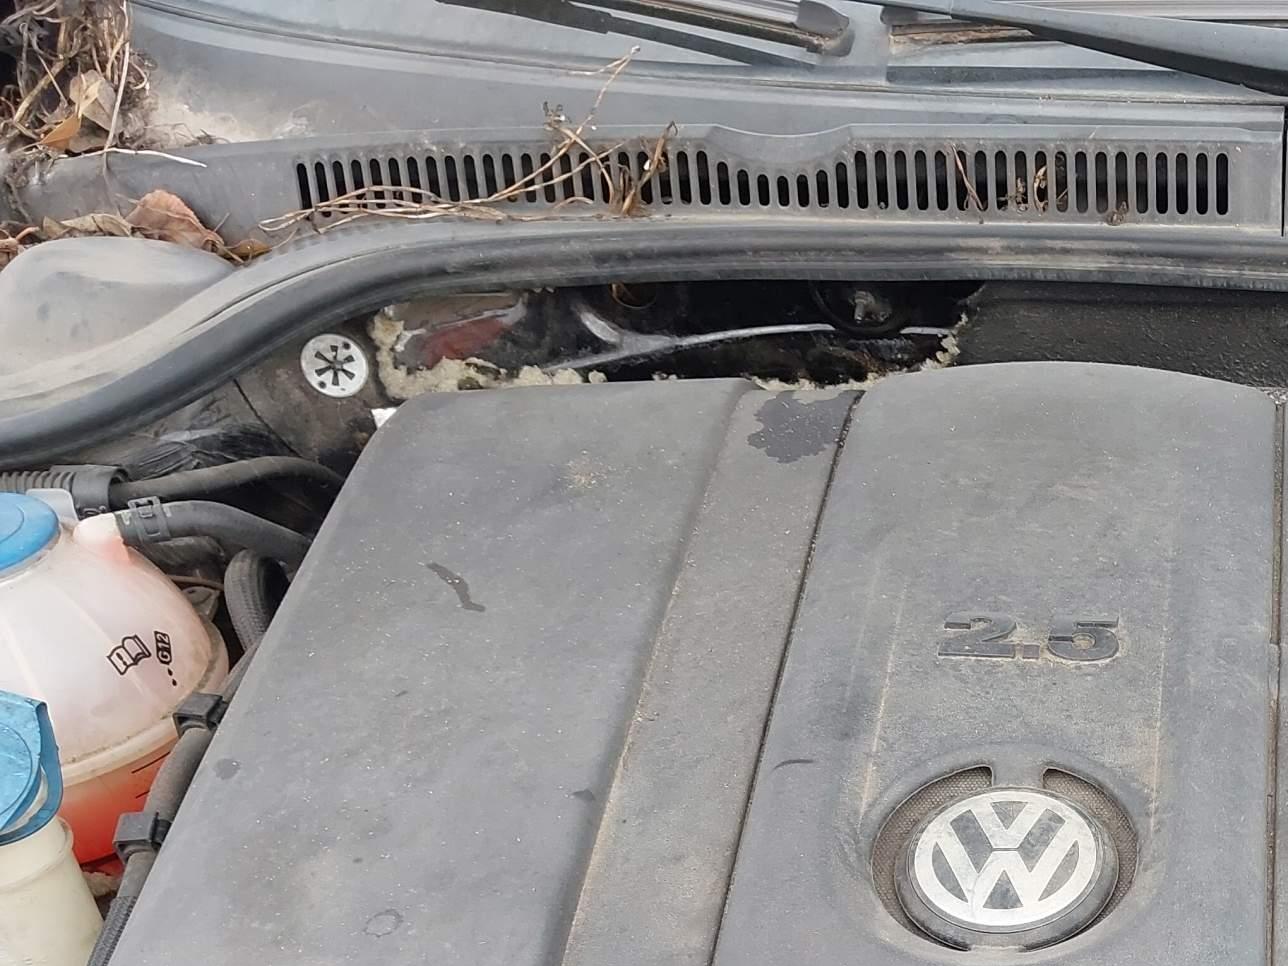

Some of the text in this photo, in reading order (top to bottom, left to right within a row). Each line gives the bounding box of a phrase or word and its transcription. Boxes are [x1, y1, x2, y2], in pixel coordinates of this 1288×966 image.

[156, 632, 171, 662] G12
[937, 611, 1121, 662] 2.5
[914, 791, 1098, 927] VW
